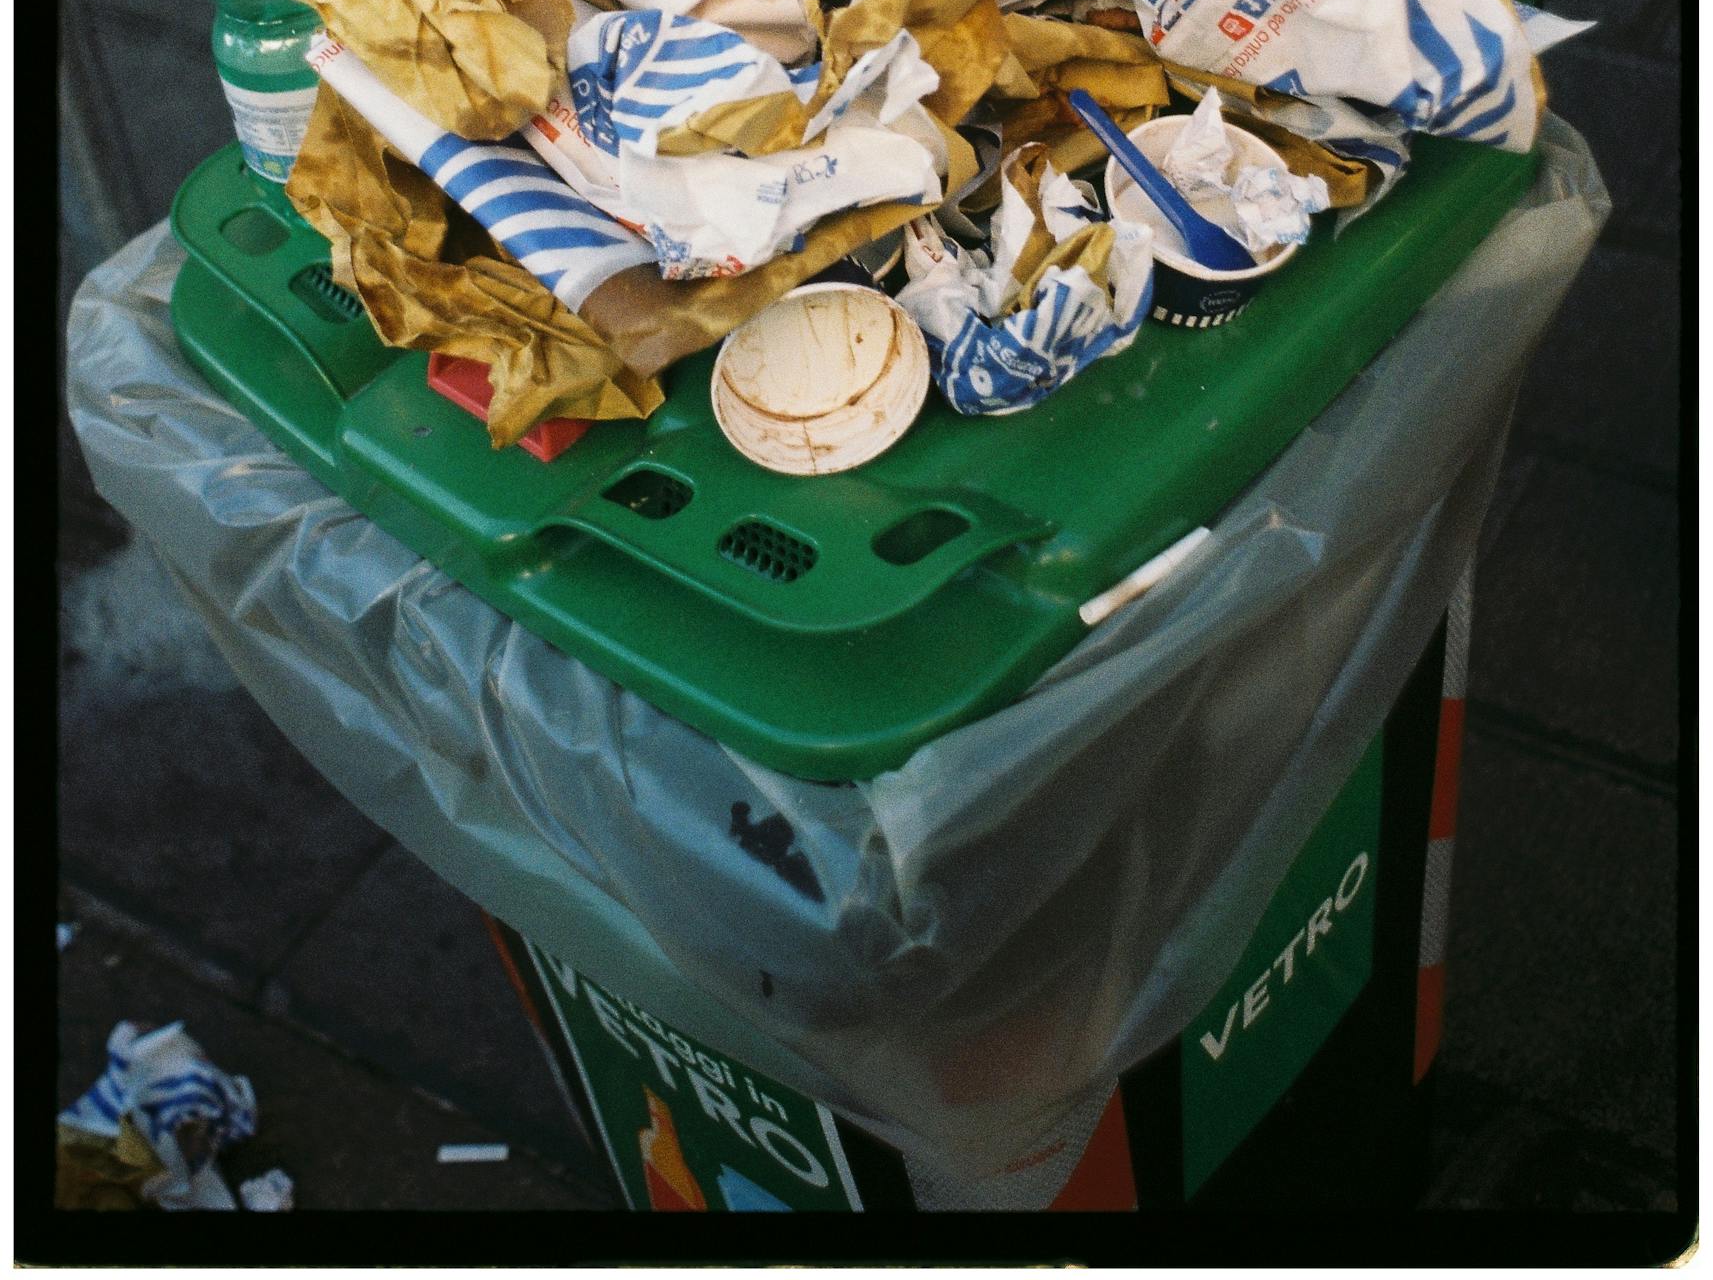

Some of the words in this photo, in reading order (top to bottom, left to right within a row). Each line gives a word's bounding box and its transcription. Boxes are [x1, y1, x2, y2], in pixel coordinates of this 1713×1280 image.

[1234, 30, 1270, 68] antica
[1199, 851, 1368, 1061] VETRO
[550, 956, 830, 1188] VETRO
[744, 1076, 789, 1122] in
